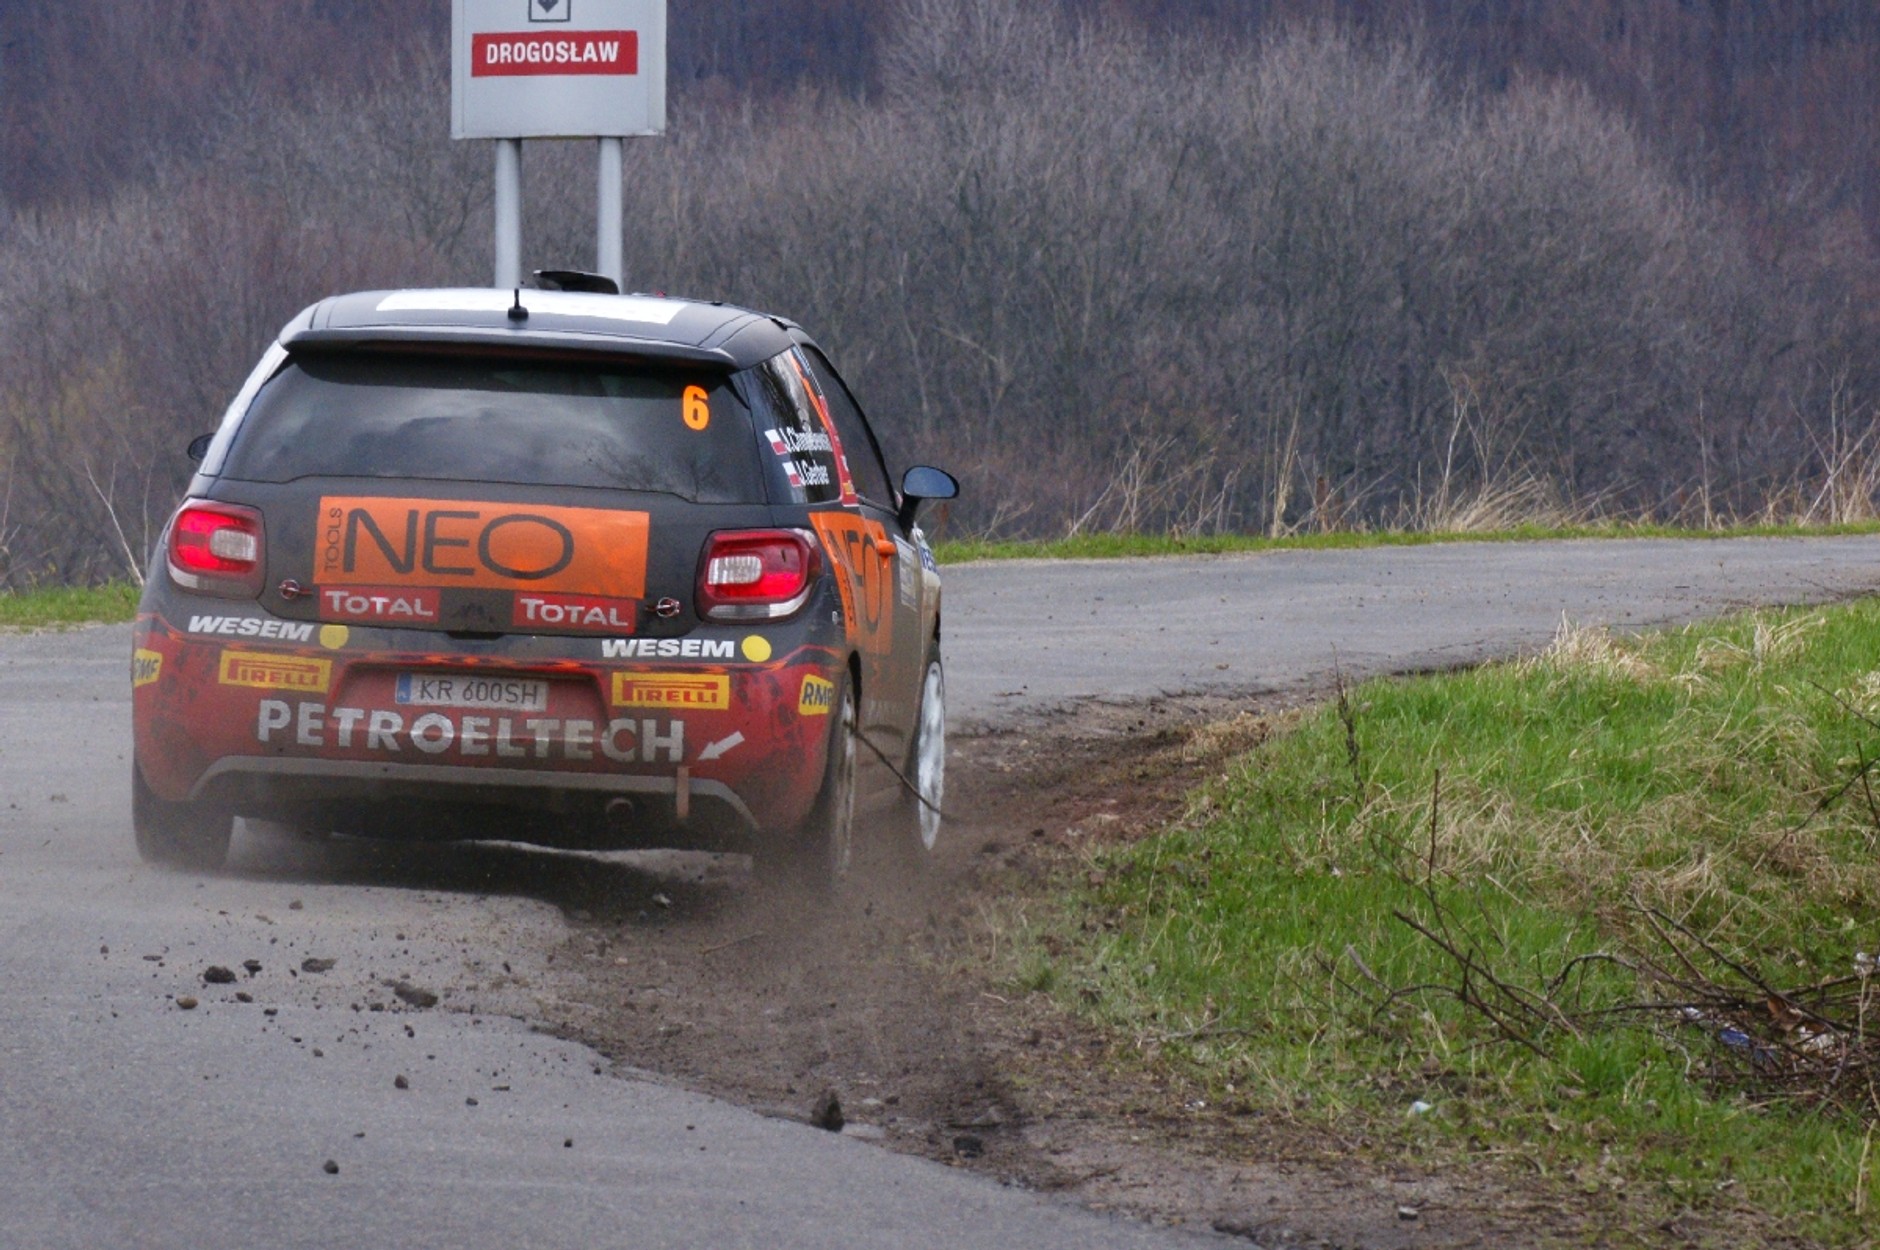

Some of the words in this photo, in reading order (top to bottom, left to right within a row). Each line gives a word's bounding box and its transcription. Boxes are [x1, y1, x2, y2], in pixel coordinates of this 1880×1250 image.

[486, 41, 619, 64] DROGOSŁAW
[682, 385, 710, 431] 6
[324, 507, 343, 573] TOOLS
[342, 507, 575, 581] NEO
[187, 615, 316, 642] WESEM
[601, 638, 736, 659] WESEM
[227, 658, 322, 688] PIRELLI
[419, 679, 454, 701] KR
[462, 681, 538, 705] 600SH
[622, 679, 719, 704] PIRELLI
[257, 699, 685, 763] PETROELTECH
